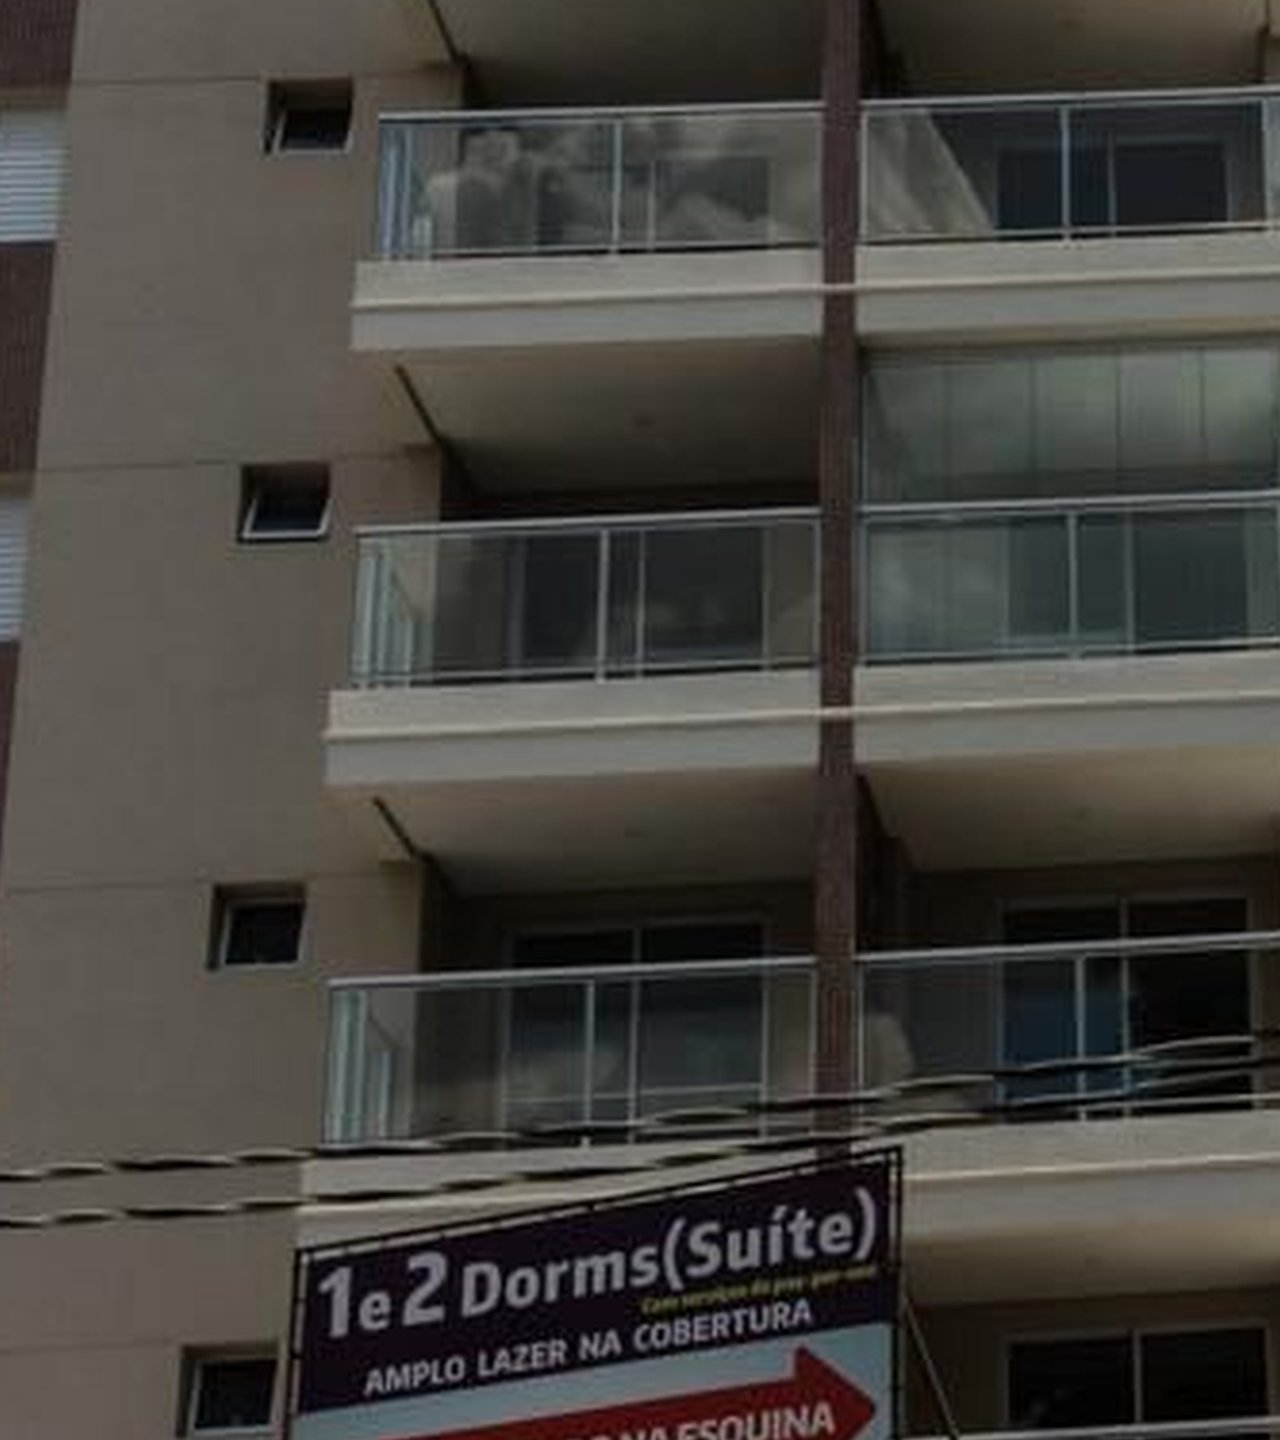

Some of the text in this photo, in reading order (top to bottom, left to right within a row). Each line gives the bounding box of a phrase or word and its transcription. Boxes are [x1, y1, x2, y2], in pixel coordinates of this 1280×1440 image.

[364, 1299, 813, 1397] AMPLO LAZER NA COBERTURA
